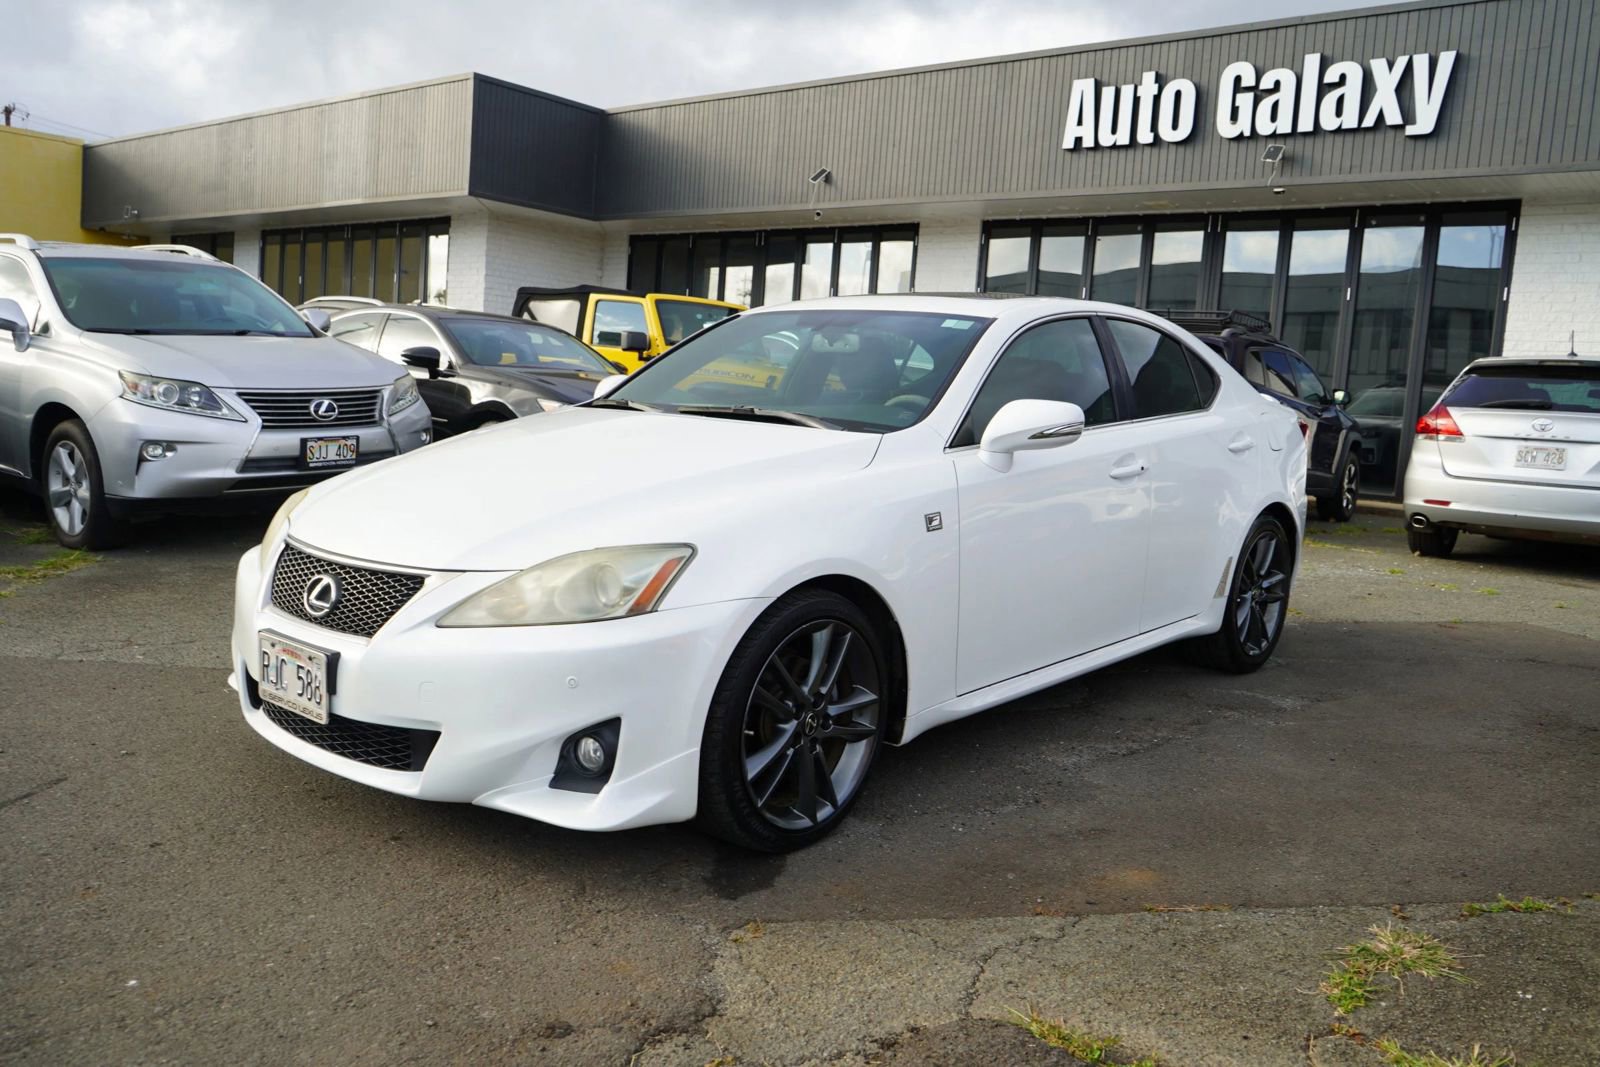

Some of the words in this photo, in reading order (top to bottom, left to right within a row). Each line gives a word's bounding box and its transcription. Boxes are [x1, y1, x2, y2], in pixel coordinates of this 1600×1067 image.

[1061, 71, 1198, 151] Auto
[1216, 50, 1458, 140] Galaxy
[308, 444, 329, 461] SJJ
[335, 443, 356, 459] 409
[1543, 450, 1565, 465] 428
[261, 649, 289, 691] RJC
